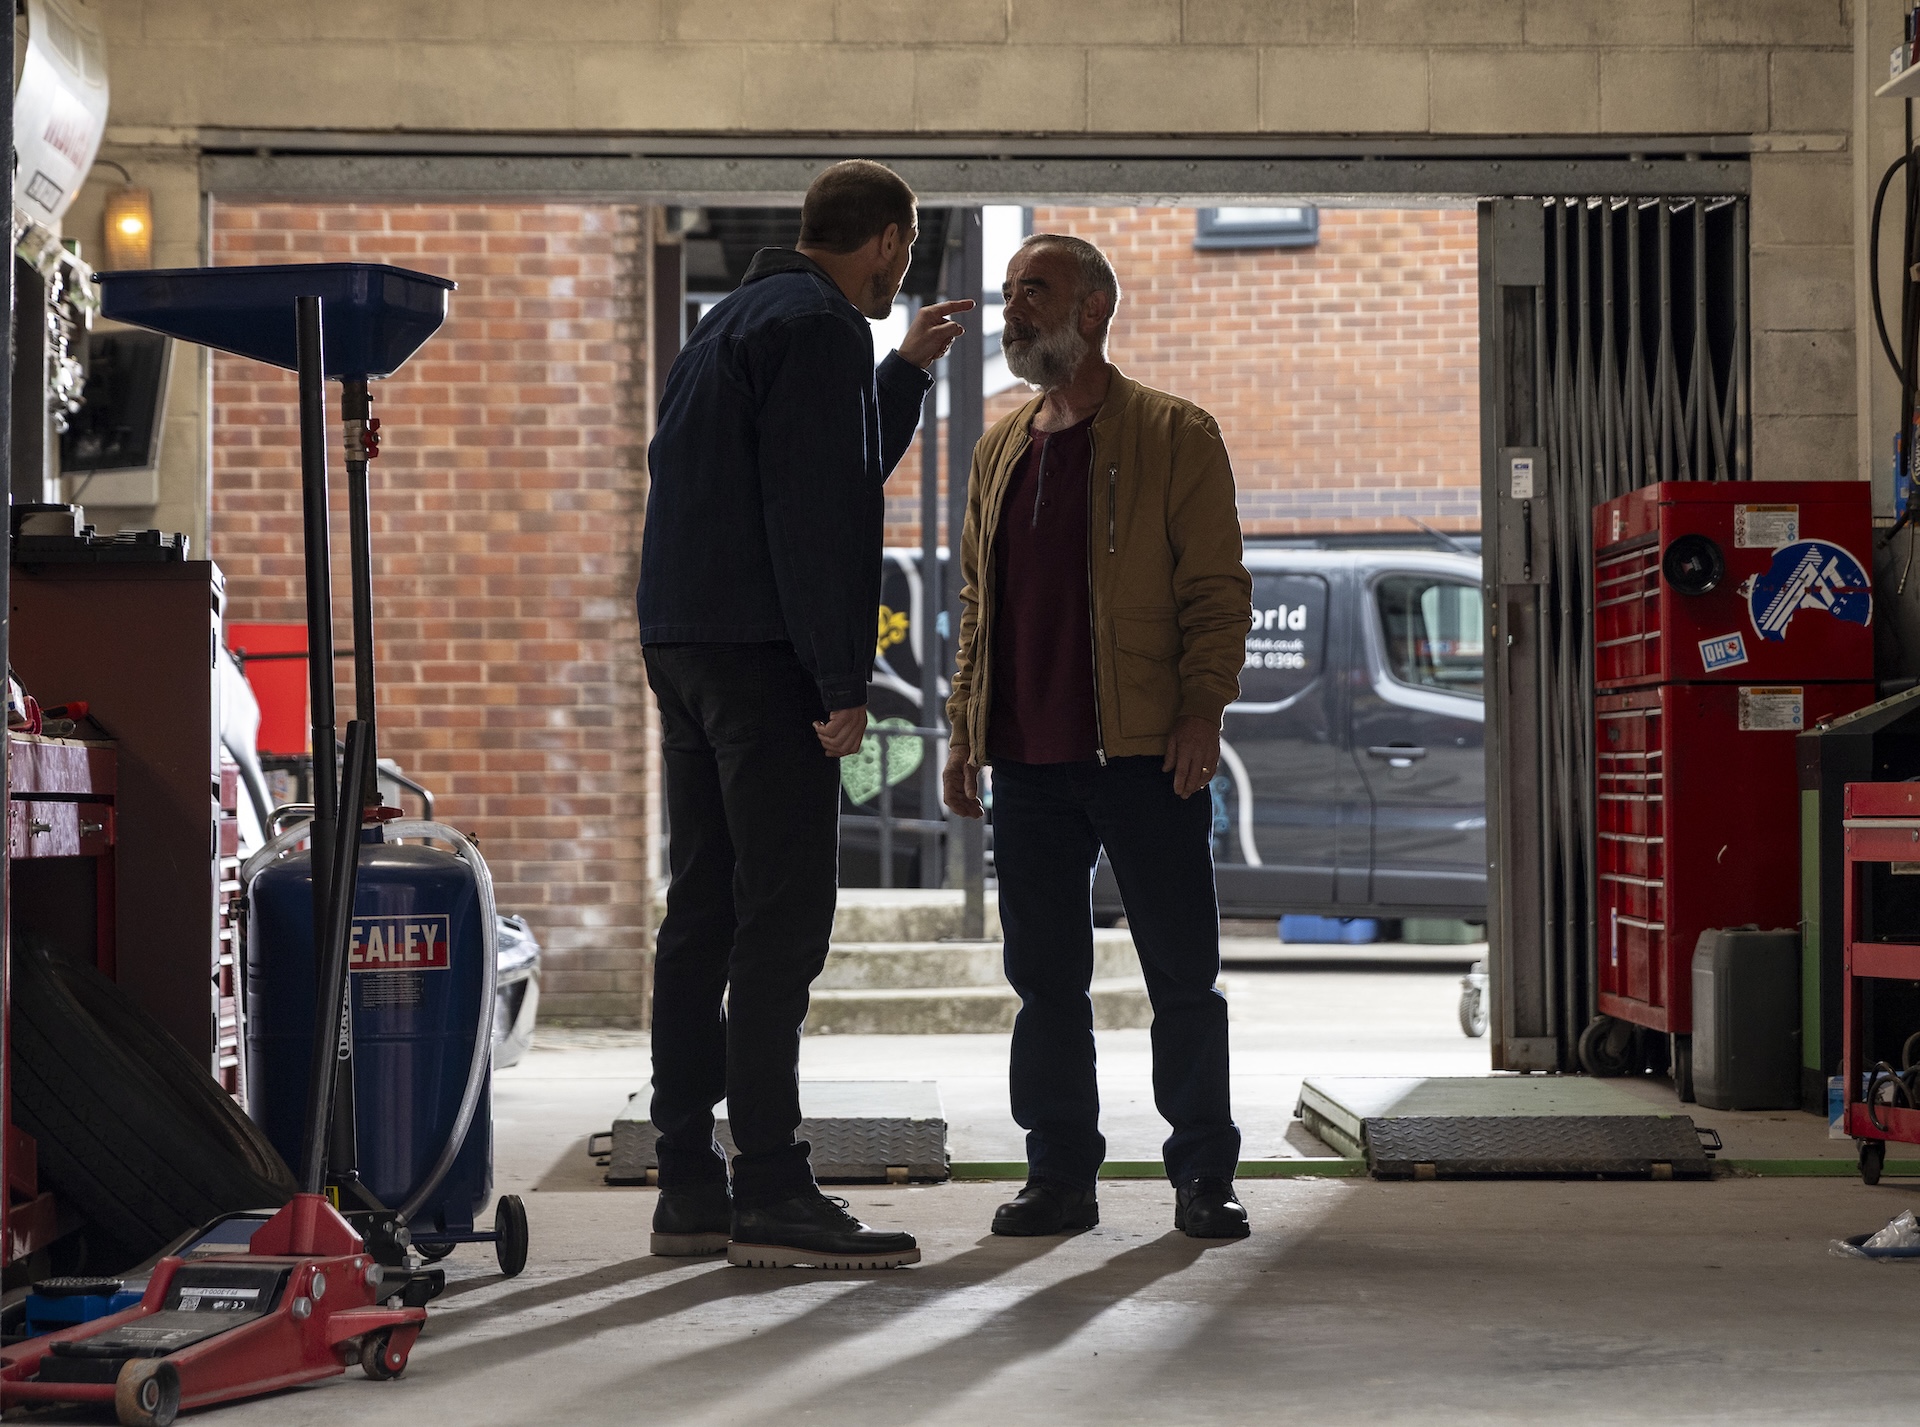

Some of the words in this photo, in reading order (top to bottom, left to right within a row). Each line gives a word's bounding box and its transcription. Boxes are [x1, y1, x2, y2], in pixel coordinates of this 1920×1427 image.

[1264, 652, 1305, 669] 0396
[1704, 642, 1726, 663] QH
[350, 924, 439, 962] EALEY
